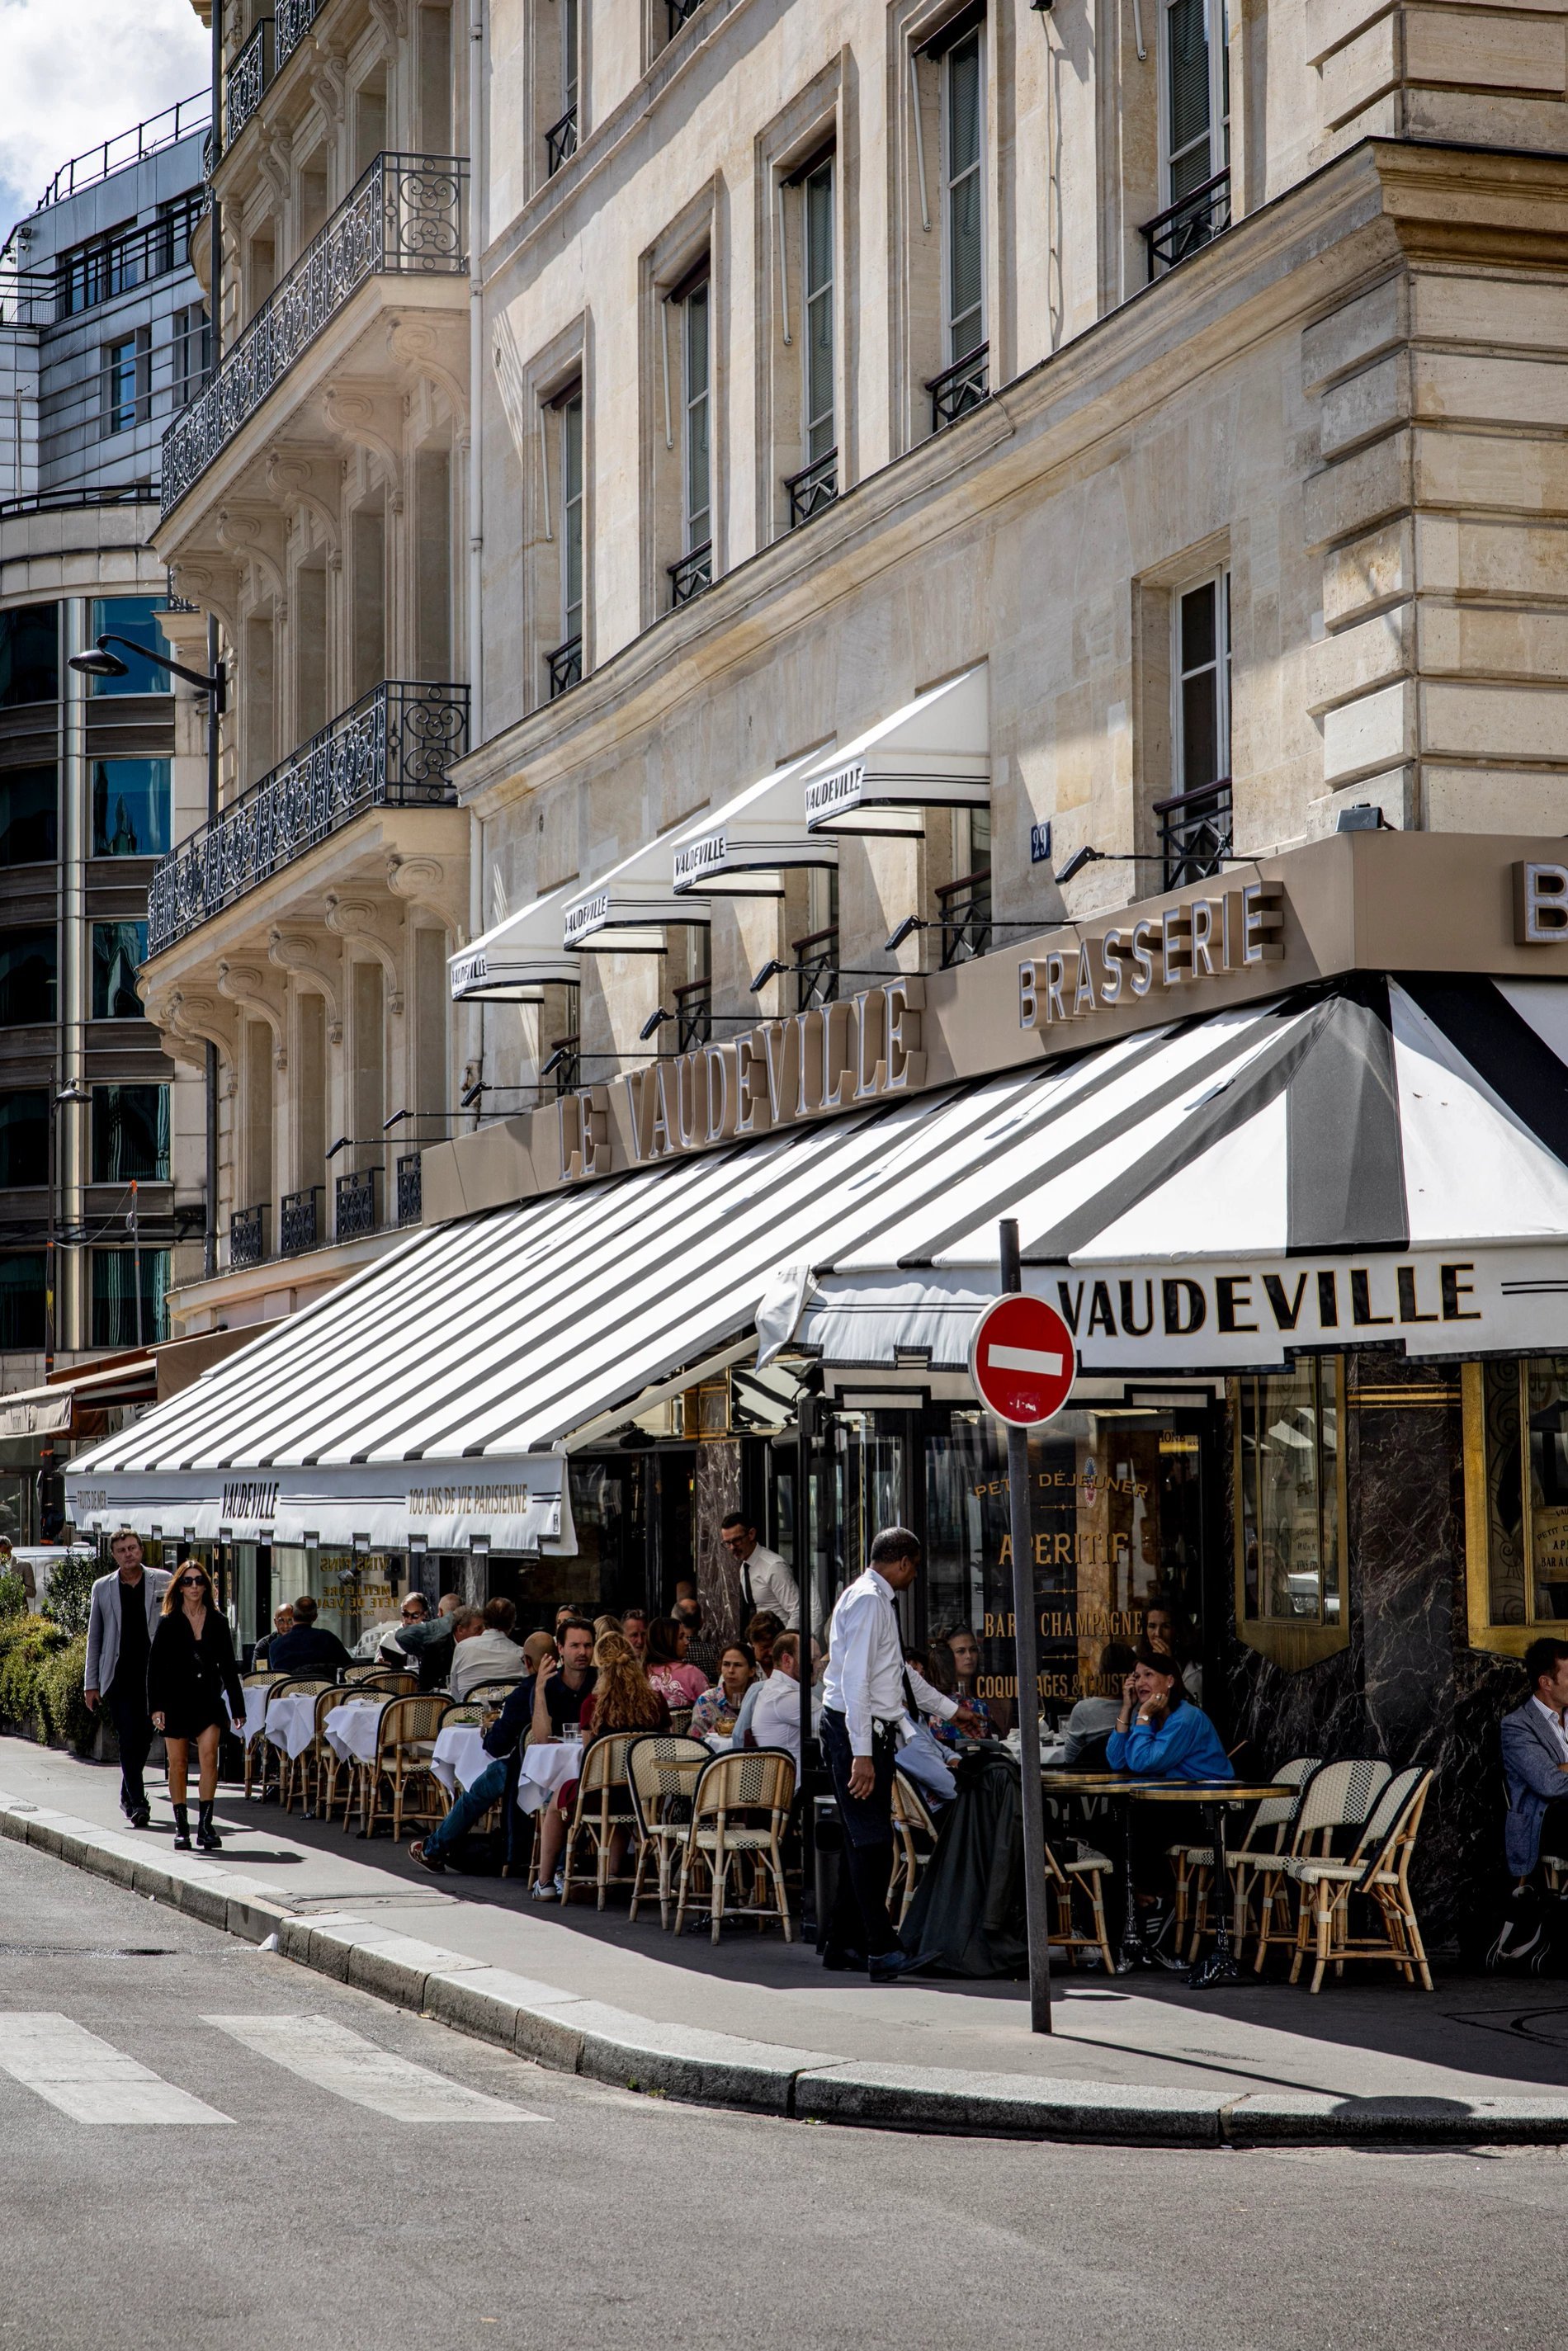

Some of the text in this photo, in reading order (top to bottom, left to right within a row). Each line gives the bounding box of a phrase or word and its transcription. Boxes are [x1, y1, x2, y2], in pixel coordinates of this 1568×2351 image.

[805, 767, 862, 812] VAUDEVILLE
[675, 837, 725, 876] VAUDEVILLE
[1032, 826, 1047, 858] 29
[564, 895, 607, 935] VAUDEVILLE
[1018, 880, 1284, 1032] BRASSERIE
[555, 976, 928, 1182] LE VAUDEVILLE
[1056, 1263, 1484, 1338] VAUDEVILLE
[221, 1482, 280, 1520] VAUDEVILLE
[409, 1484, 528, 1515] 100 ANS DE VIE PARISIENNE
[1039, 1470, 1148, 1499] DÉJEUNER
[999, 1532, 1129, 1565] AERITIF
[1041, 1611, 1143, 1636] CHAMPAGNE
[976, 1674, 1068, 1698] COQUIAGES
